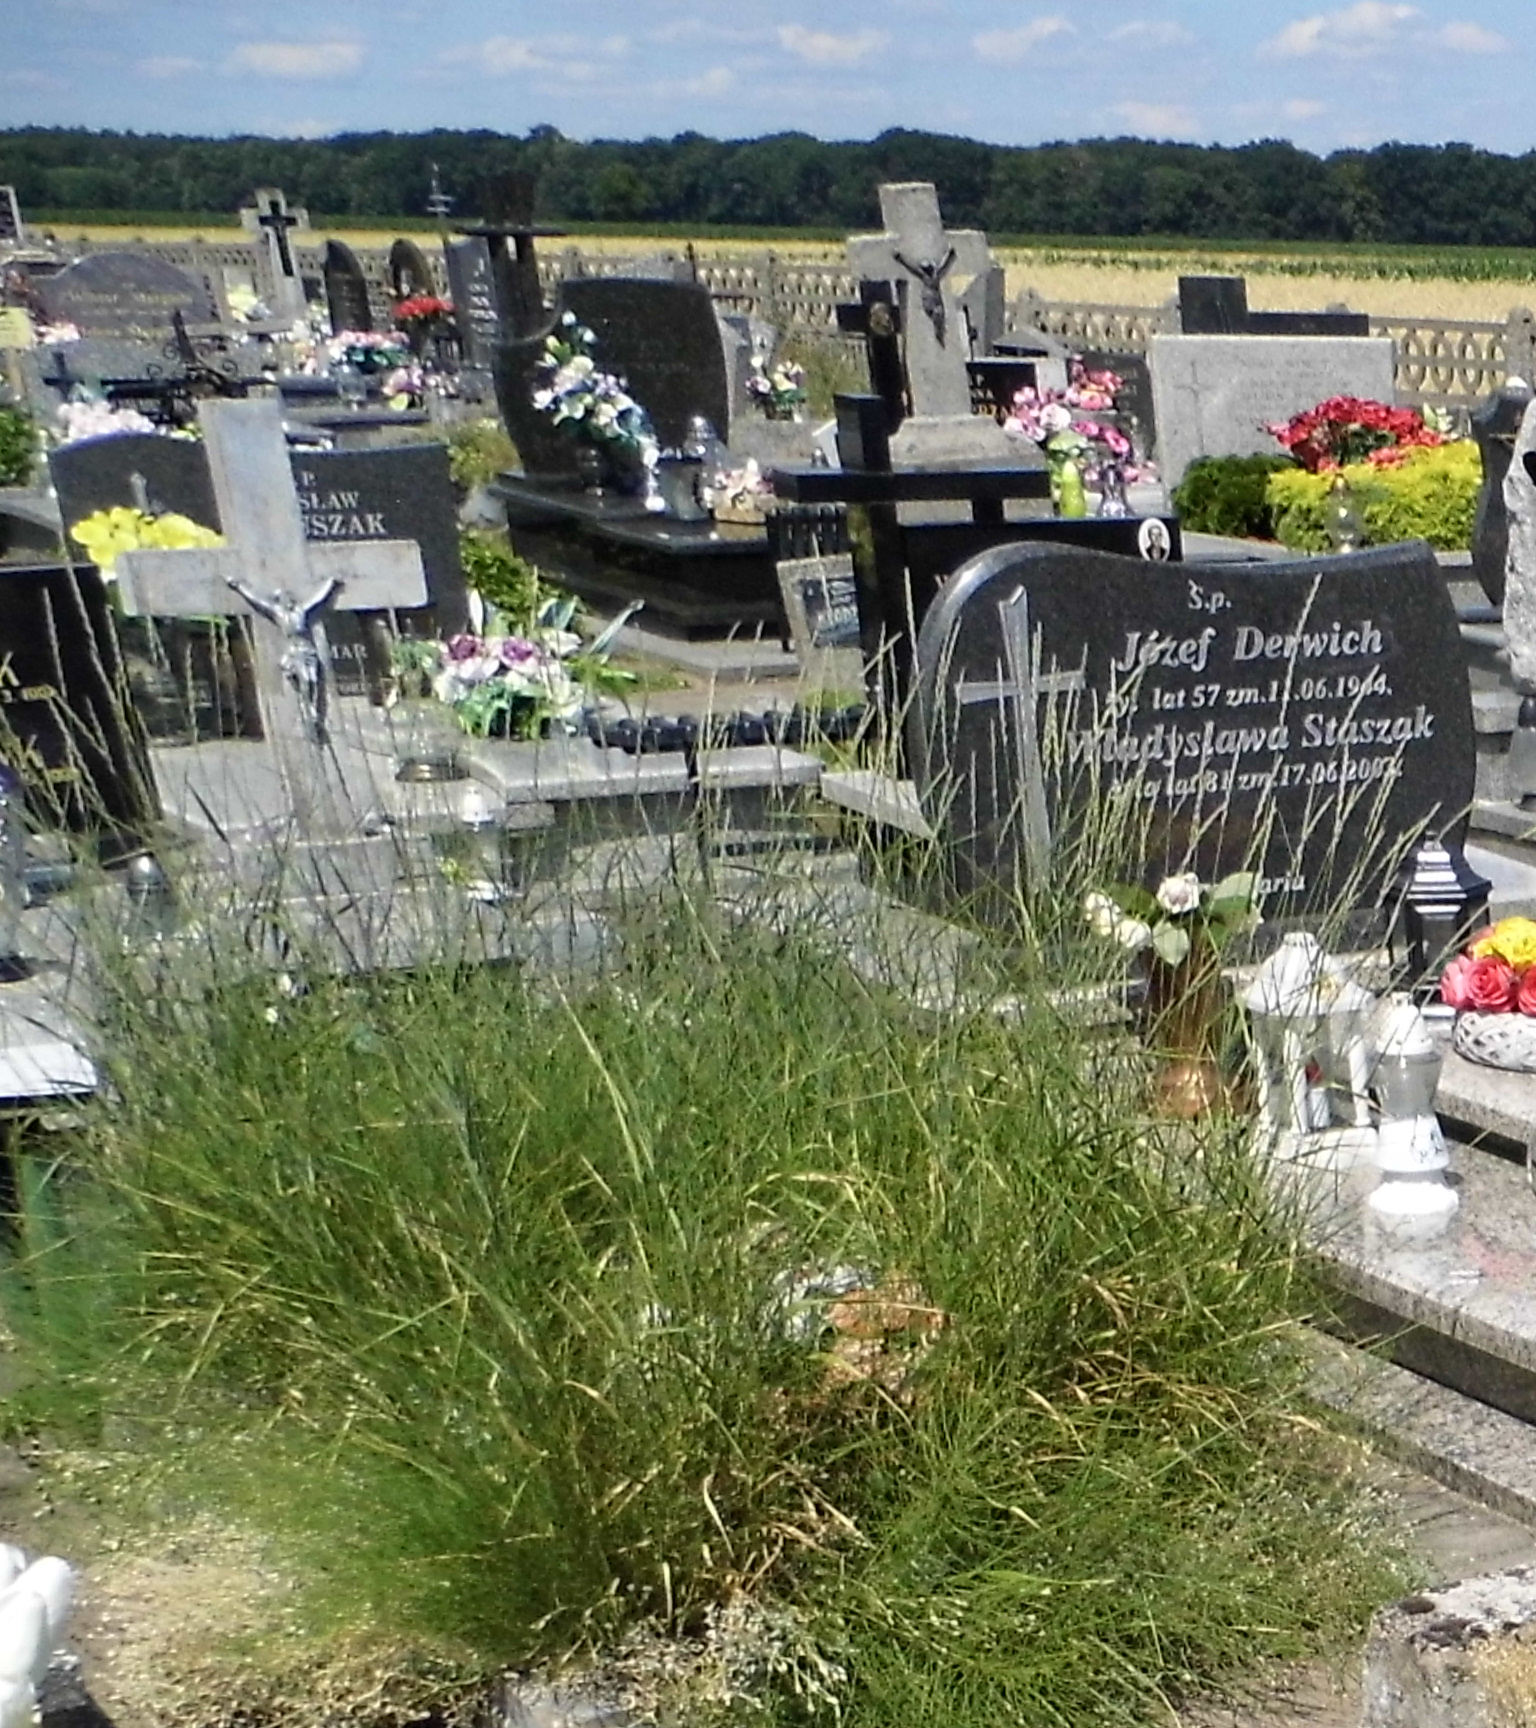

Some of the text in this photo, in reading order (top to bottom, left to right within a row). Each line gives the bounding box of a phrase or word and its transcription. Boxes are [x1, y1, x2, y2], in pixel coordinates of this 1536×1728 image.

[1233, 620, 1384, 661] Derwich
[1153, 686, 1185, 711] lat
[1191, 684, 1222, 708] 57
[1301, 704, 1436, 750] Staszak
